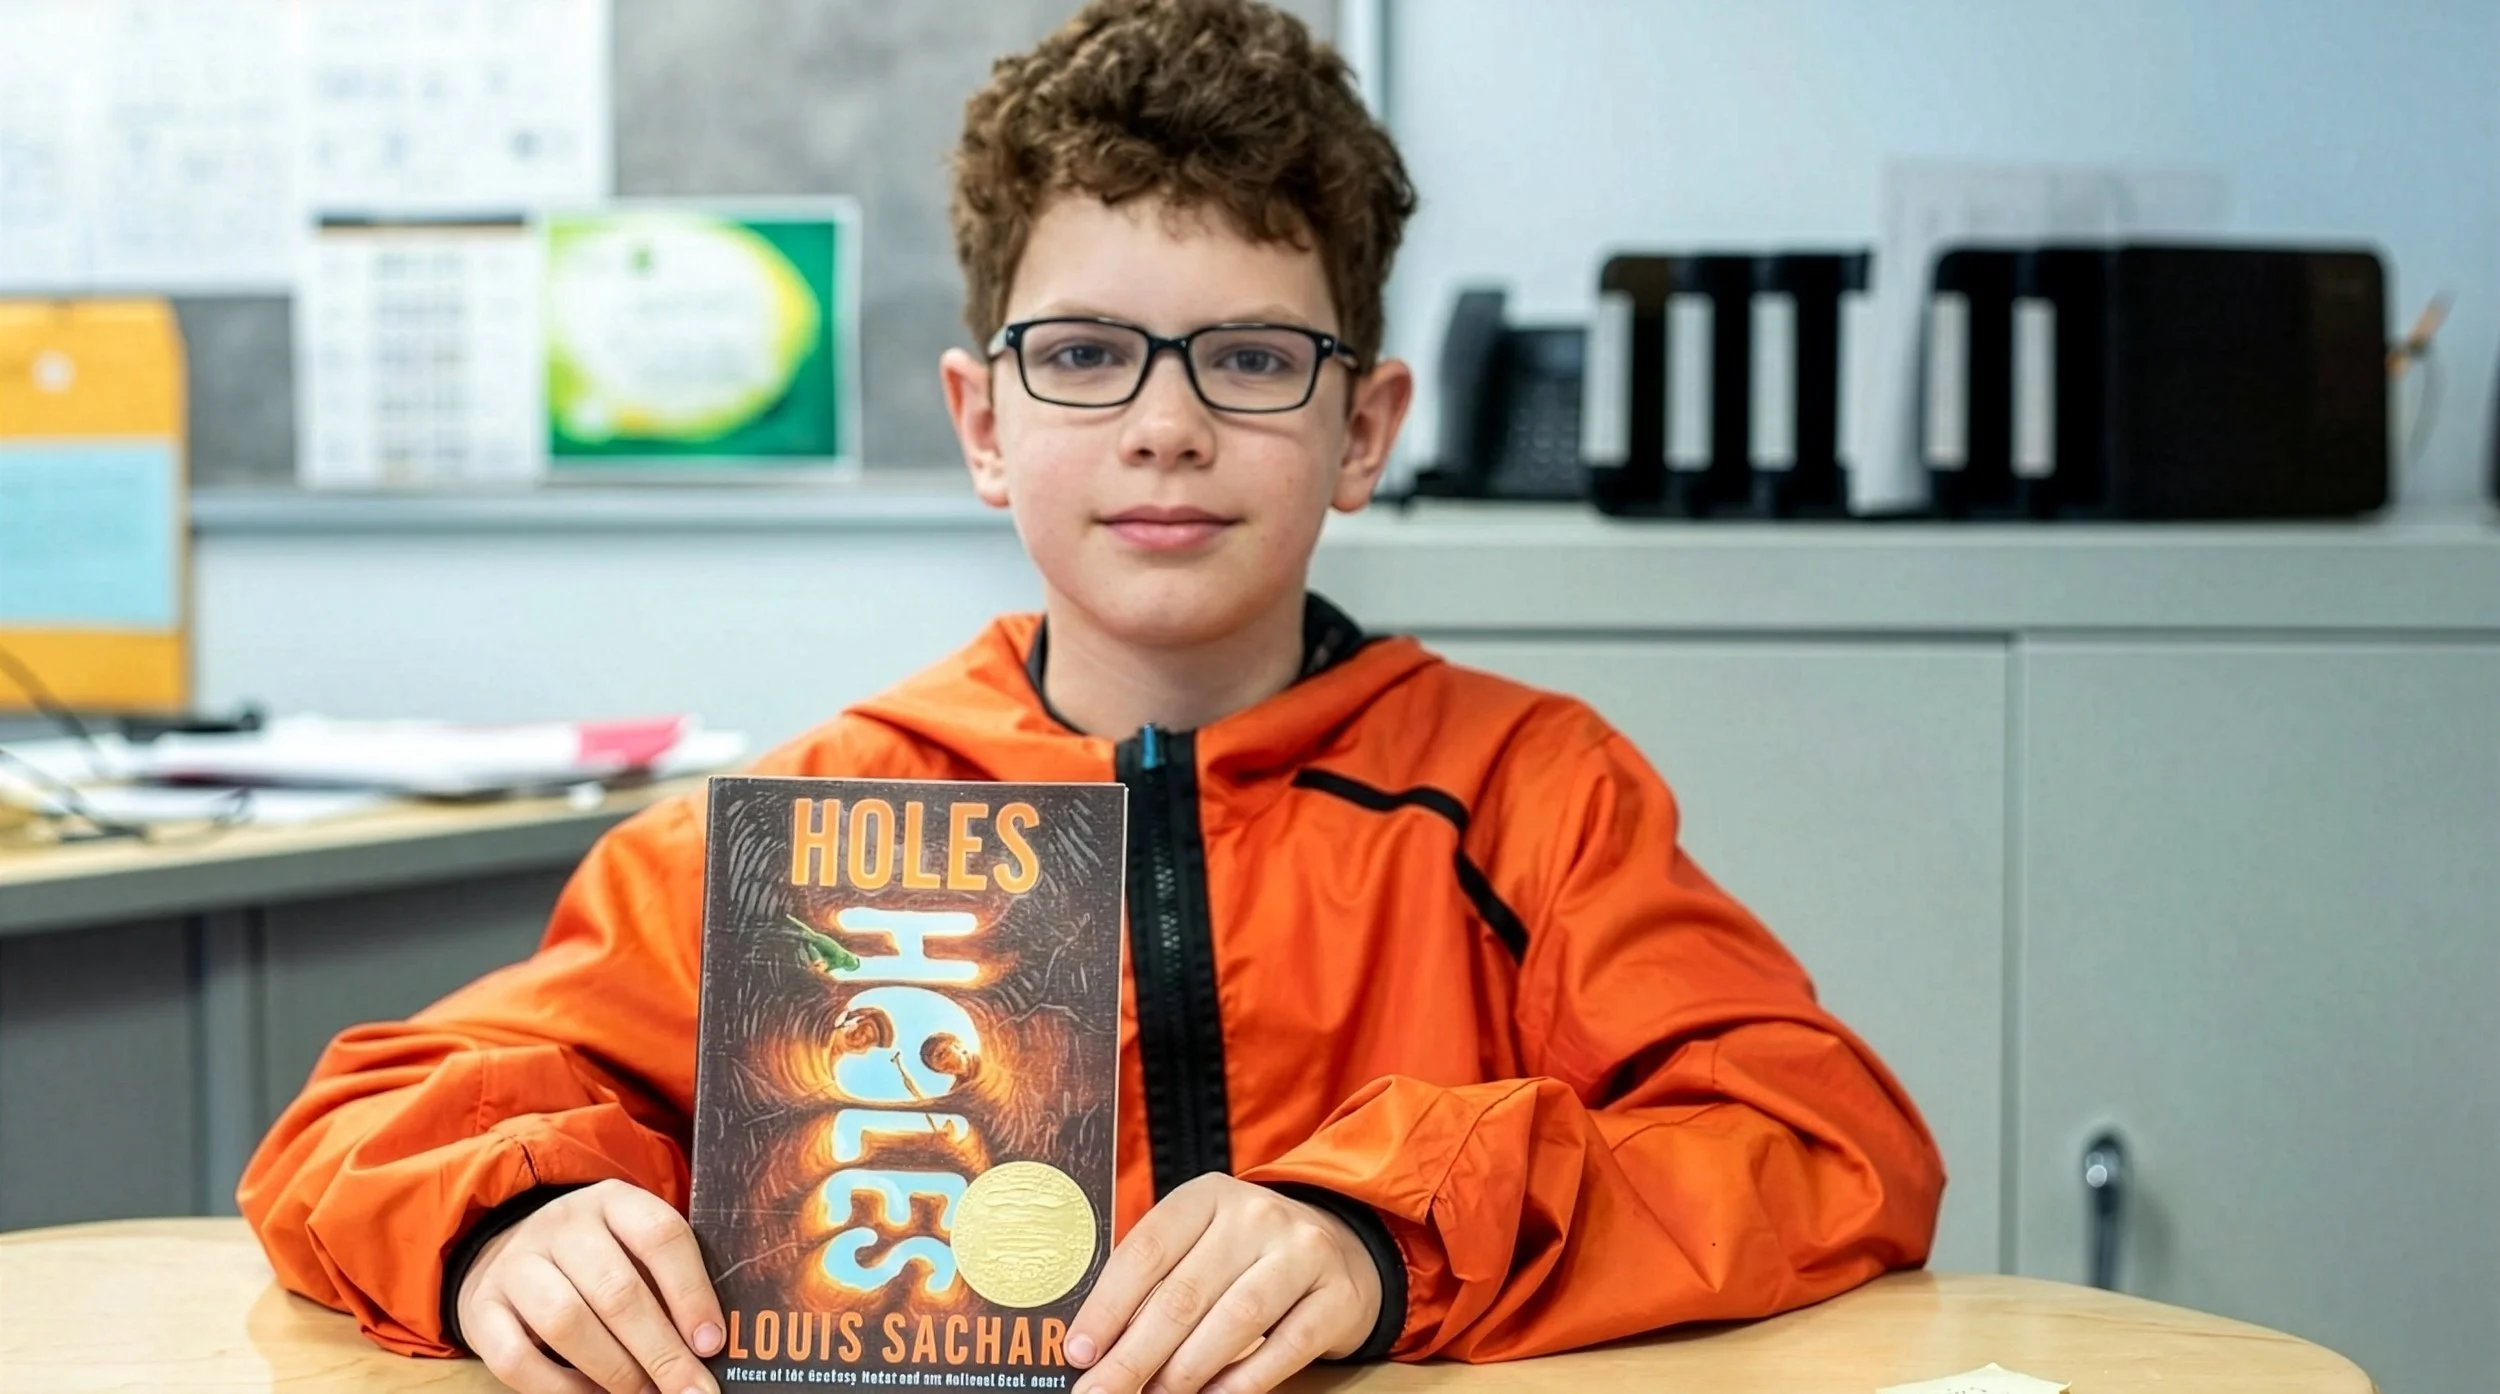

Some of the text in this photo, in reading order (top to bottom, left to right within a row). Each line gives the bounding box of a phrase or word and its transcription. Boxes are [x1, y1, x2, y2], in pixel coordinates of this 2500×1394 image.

[790, 797, 1041, 895] HOLES
[818, 906, 983, 1294] HOLES
[728, 1309, 1067, 1367] LOUIS SACHAR
